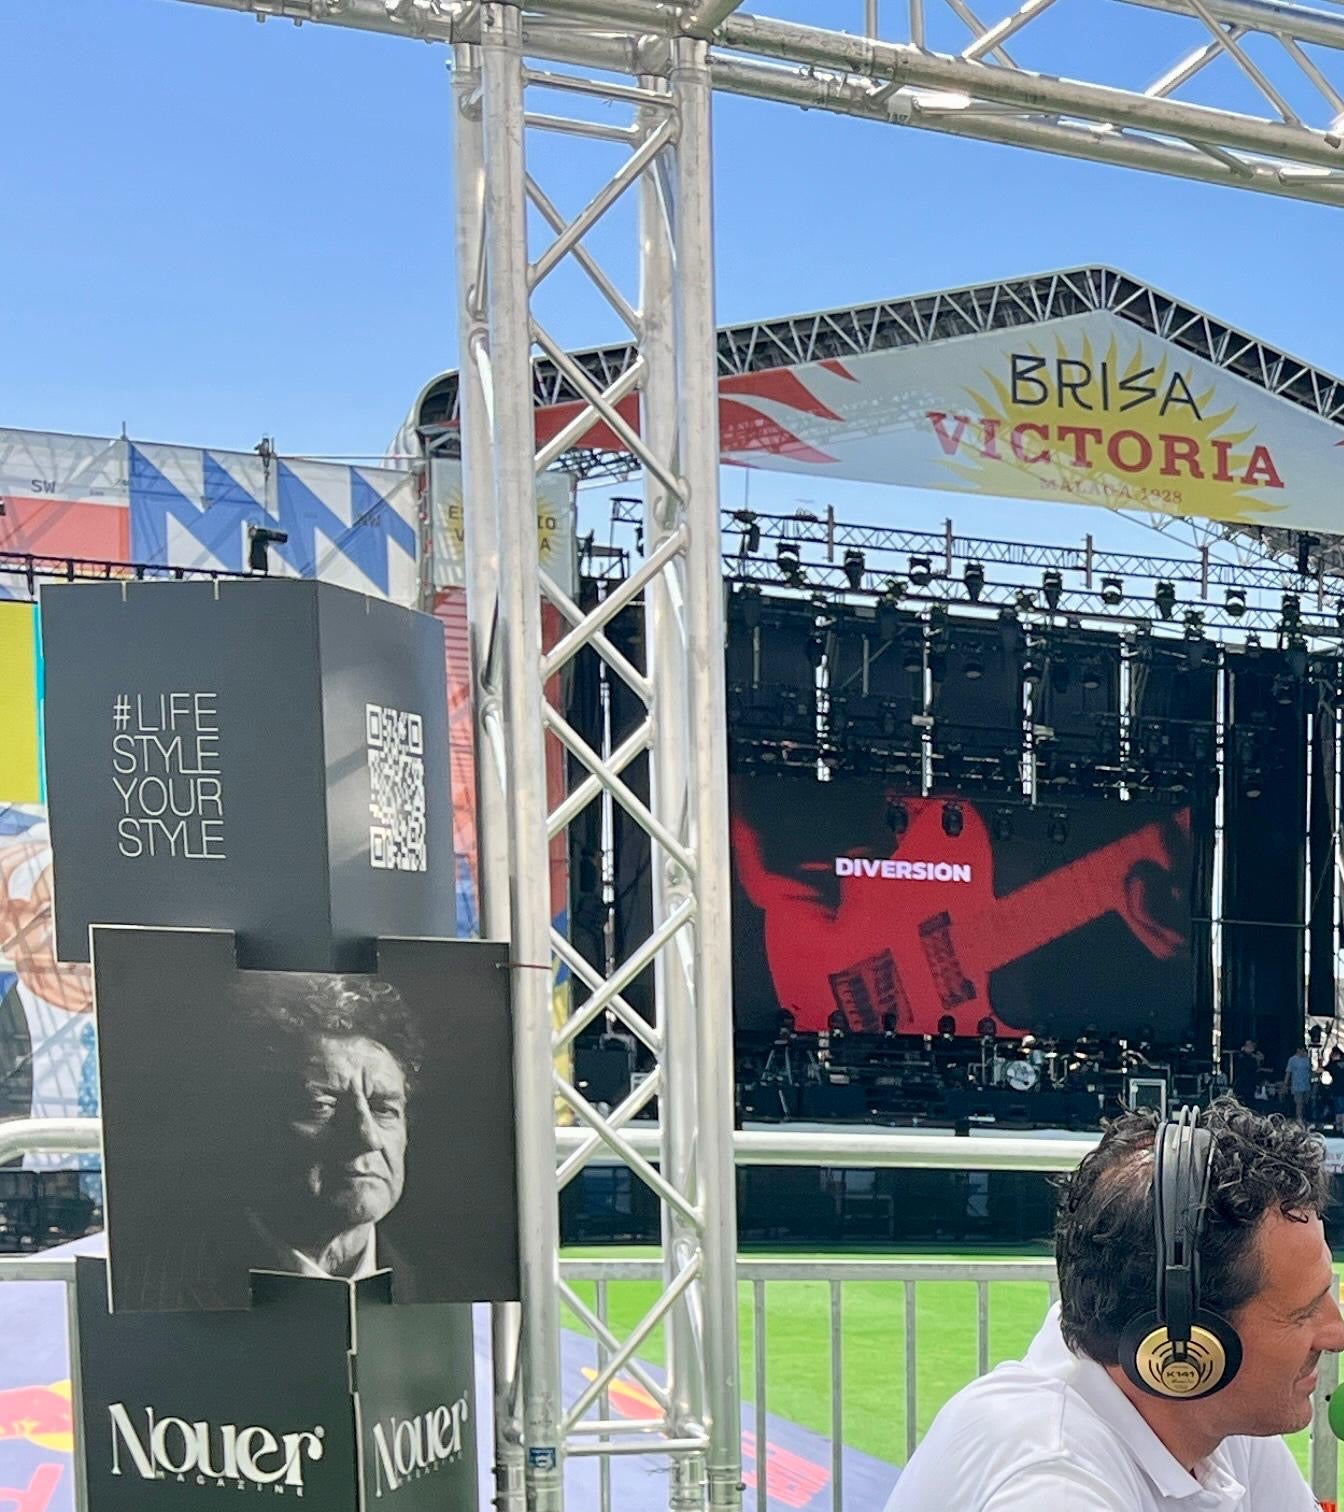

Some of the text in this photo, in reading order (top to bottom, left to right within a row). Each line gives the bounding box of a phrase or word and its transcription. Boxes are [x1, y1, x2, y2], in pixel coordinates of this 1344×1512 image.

[1010, 353, 1203, 422] BRISA
[925, 410, 1285, 489] VICTORIA
[1141, 487, 1183, 504] 1928
[113, 693, 219, 731] #LIFE
[112, 734, 222, 775] STYLE
[112, 776, 223, 817] YOUR
[117, 818, 227, 859] STYLE
[108, 1402, 324, 1485] Nouer
[373, 1397, 469, 1498] Nouer
